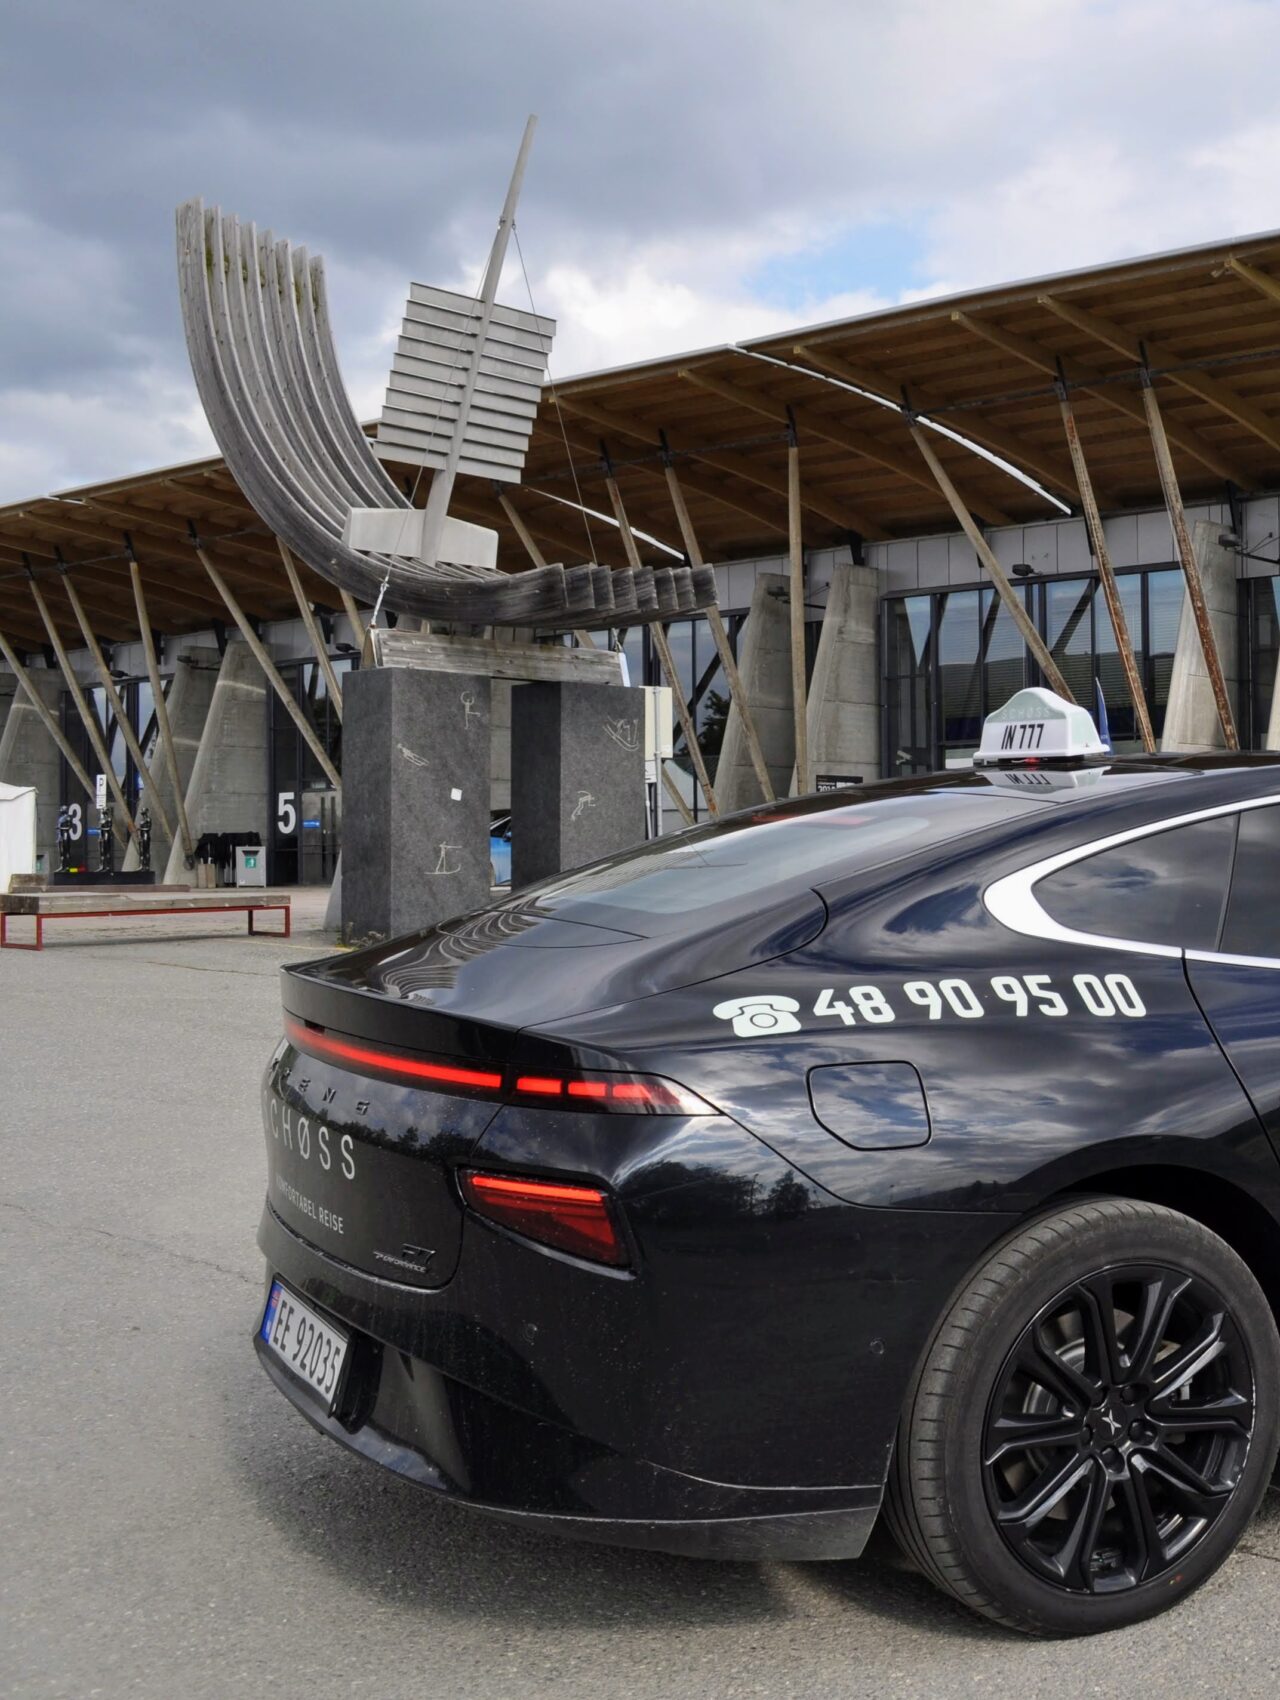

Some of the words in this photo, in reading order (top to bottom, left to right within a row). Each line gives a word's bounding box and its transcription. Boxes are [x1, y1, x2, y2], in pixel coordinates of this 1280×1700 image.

[1001, 725, 1017, 749] IN
[1019, 723, 1044, 749] 777
[68, 803, 82, 840] 3
[277, 792, 296, 834] 5
[813, 985, 896, 1026] 48
[903, 979, 985, 1020] 90
[990, 975, 1069, 1017] 95
[1072, 973, 1147, 1017] 00
[319, 1206, 344, 1234] REISE
[272, 1299, 295, 1353] EE
[292, 1316, 341, 1395] 92035
